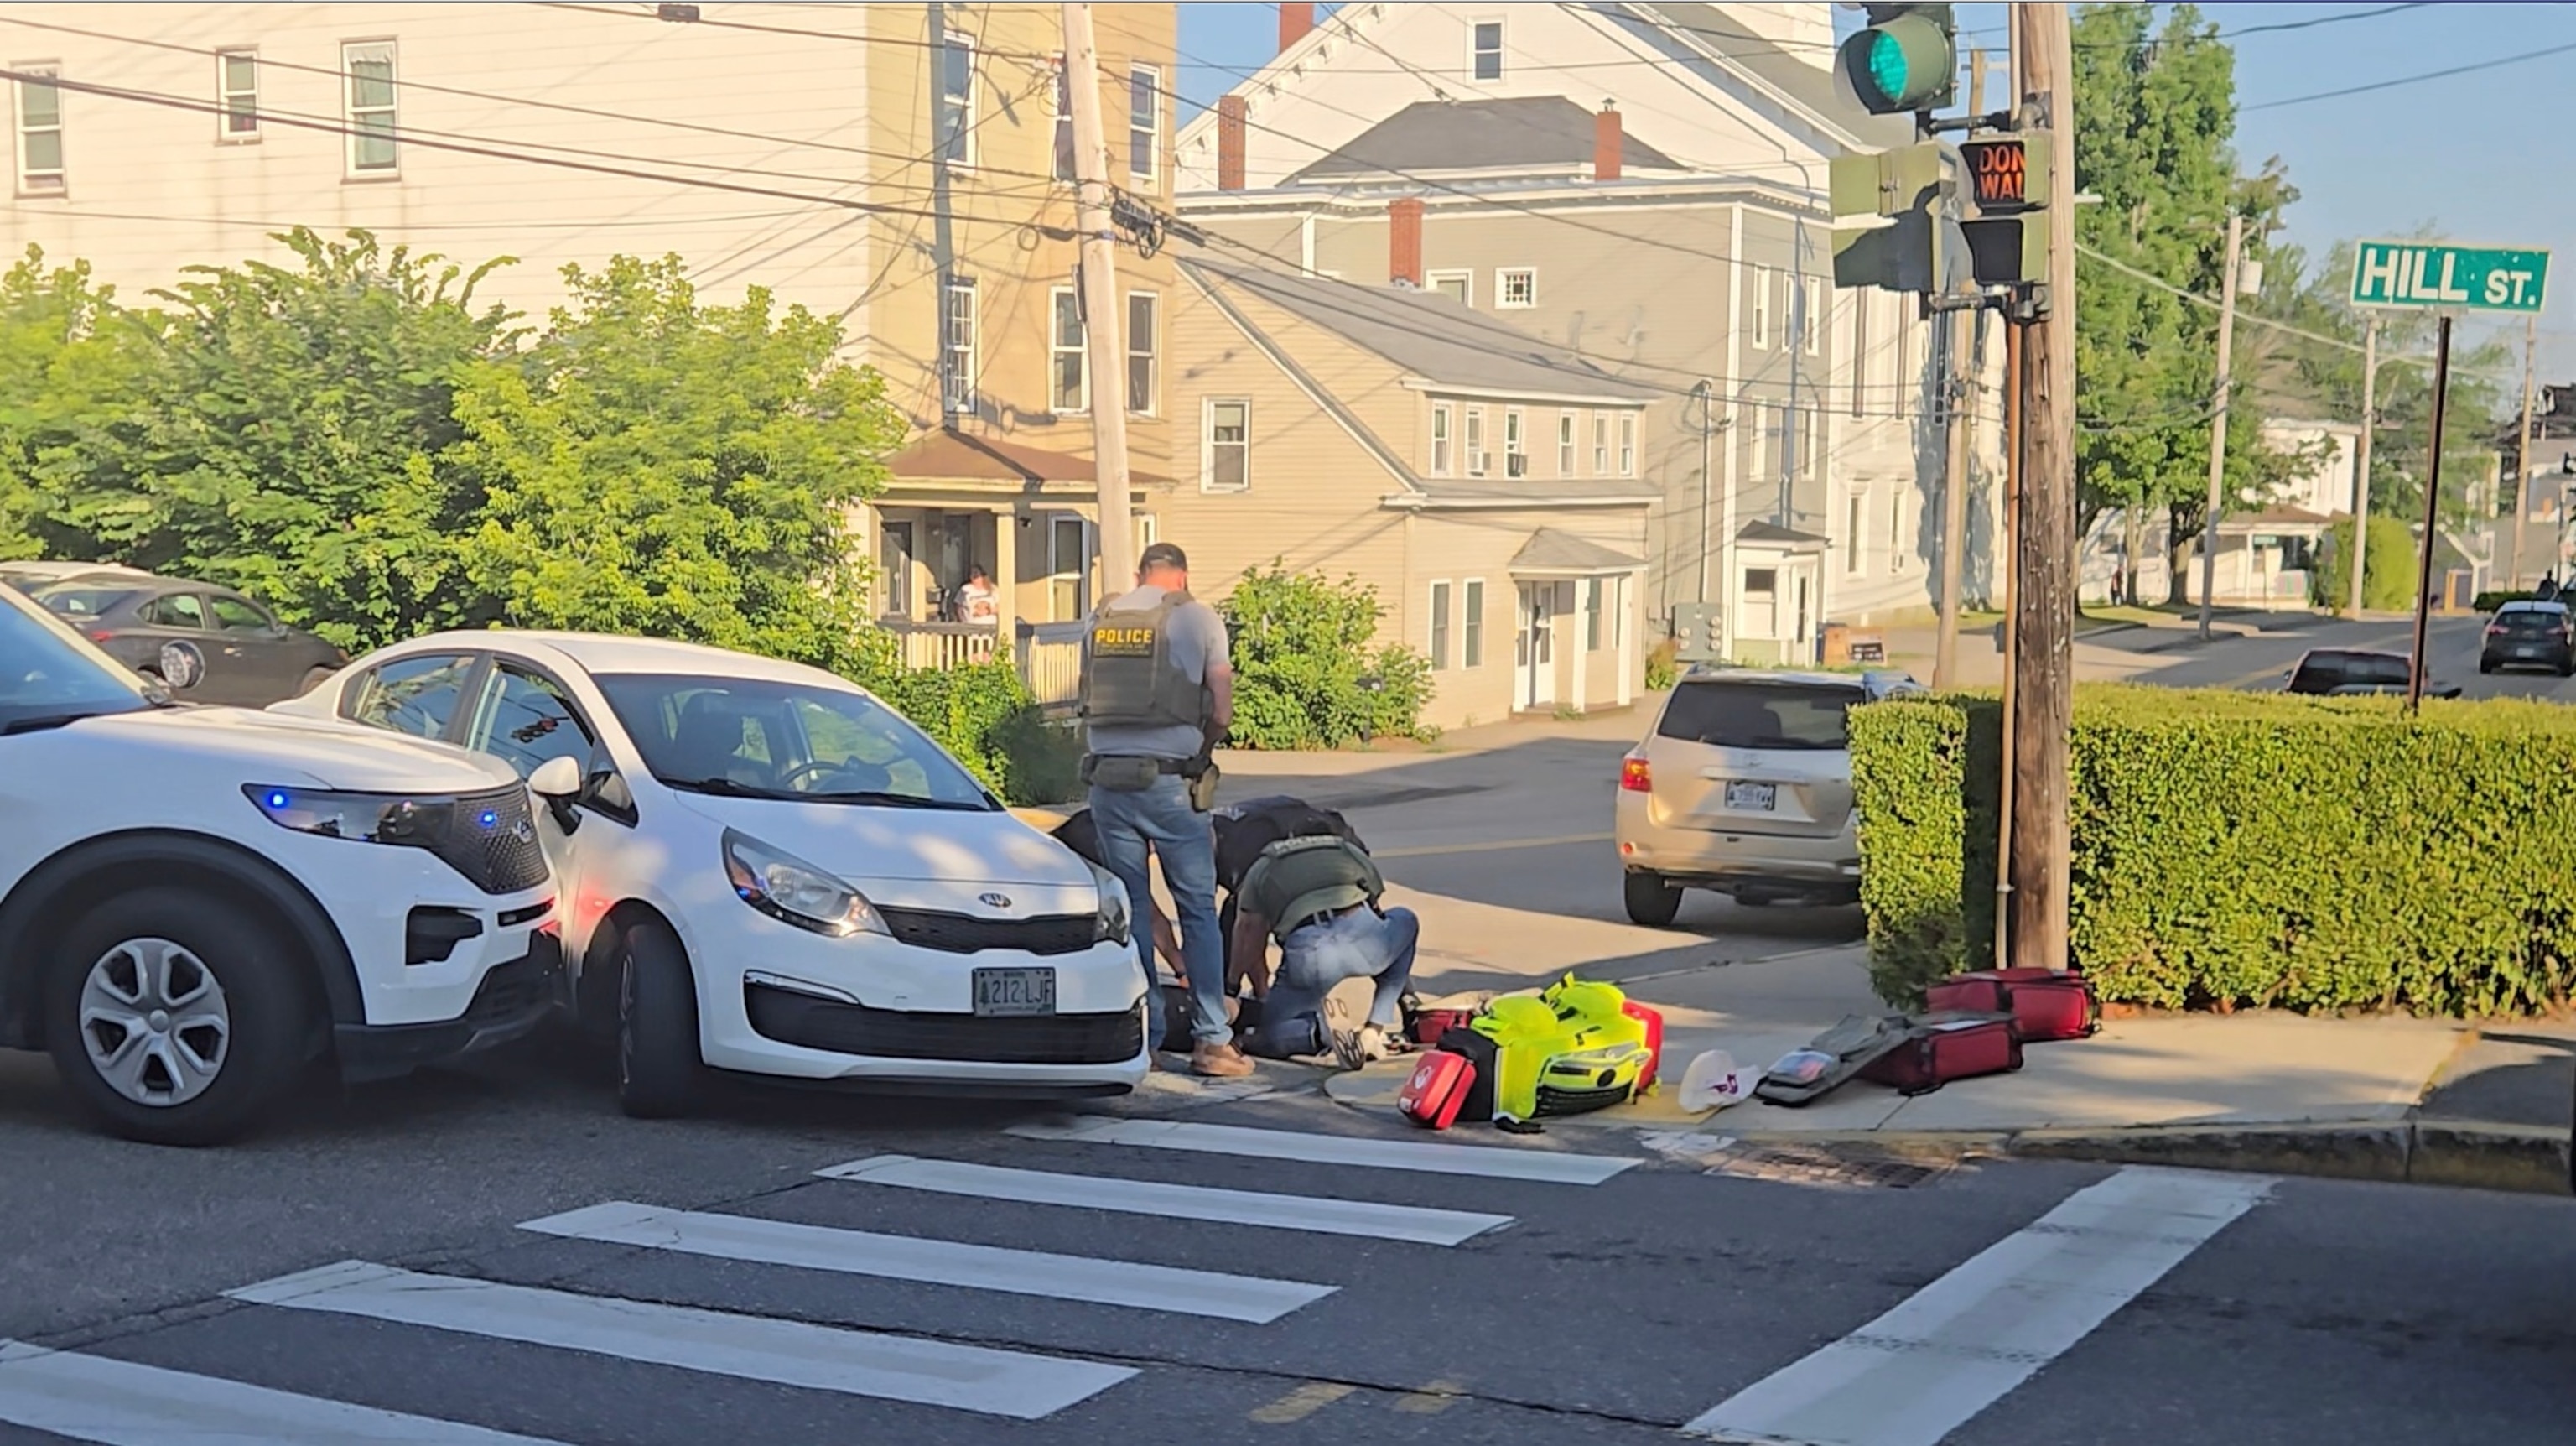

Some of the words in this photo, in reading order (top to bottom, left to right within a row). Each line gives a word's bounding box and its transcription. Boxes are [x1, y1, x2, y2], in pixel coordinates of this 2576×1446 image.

[2360, 248, 2469, 301] HILL
[2485, 269, 2537, 305] ST.
[1095, 629, 1153, 643] POLICE
